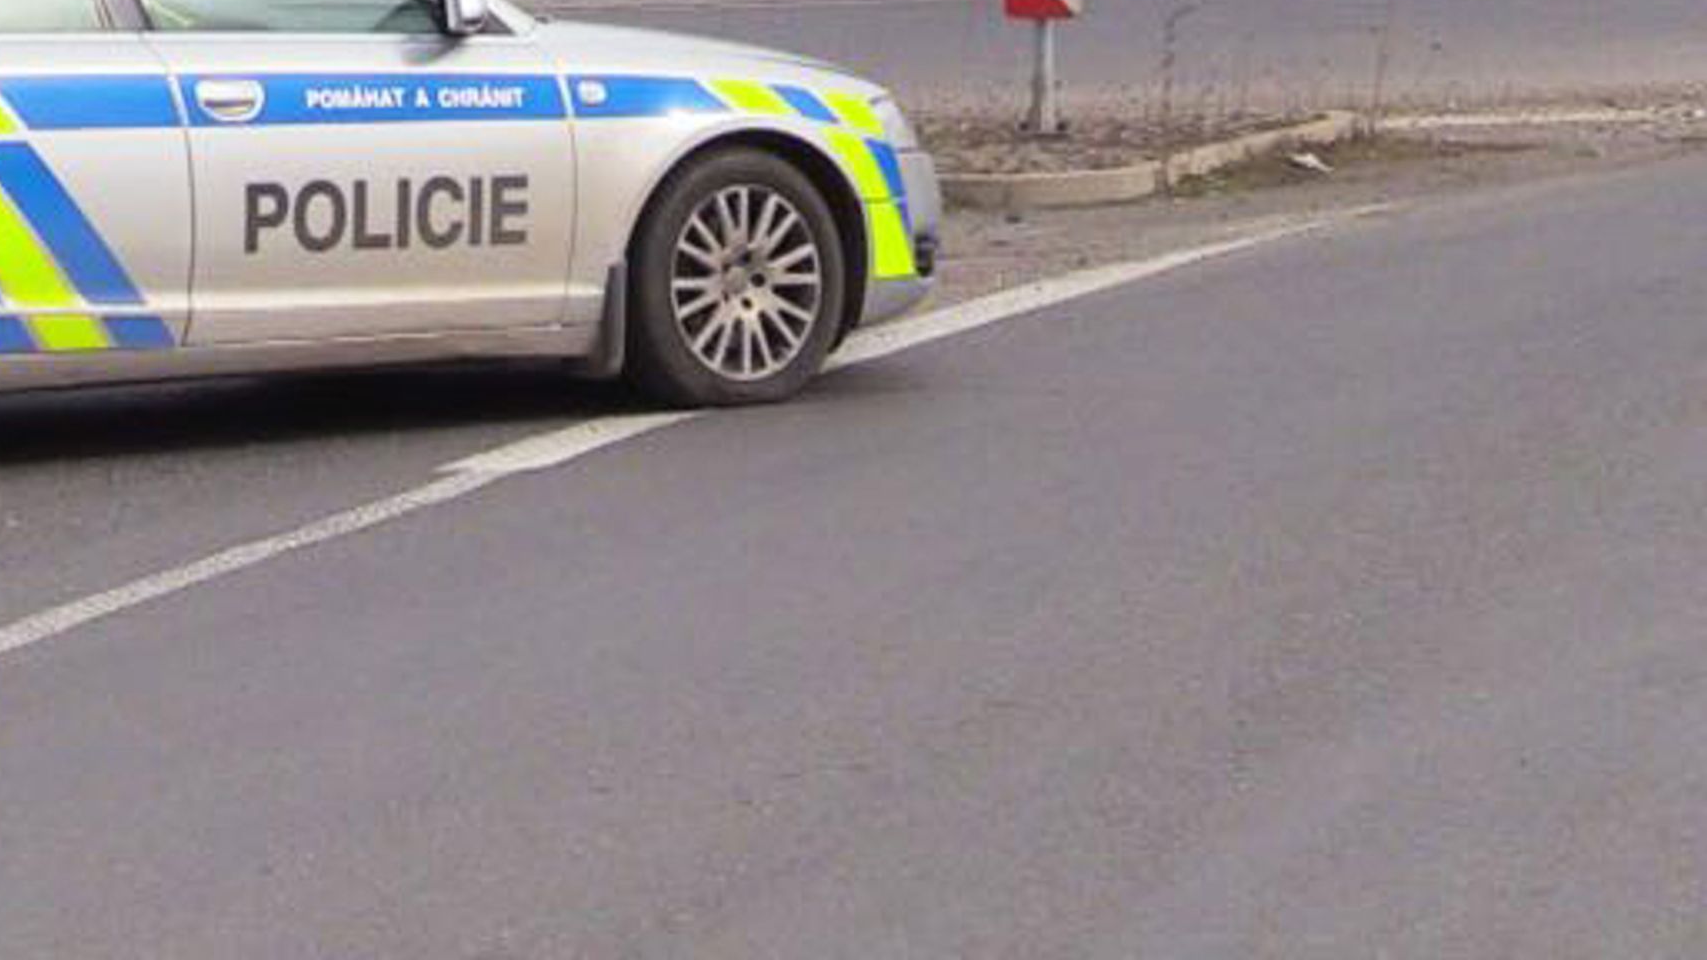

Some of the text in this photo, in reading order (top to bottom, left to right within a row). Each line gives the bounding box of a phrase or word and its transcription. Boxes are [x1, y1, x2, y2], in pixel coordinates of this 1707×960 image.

[306, 84, 406, 108] POMÁHAT
[415, 88, 430, 108] A
[244, 174, 530, 254] POLICIE
